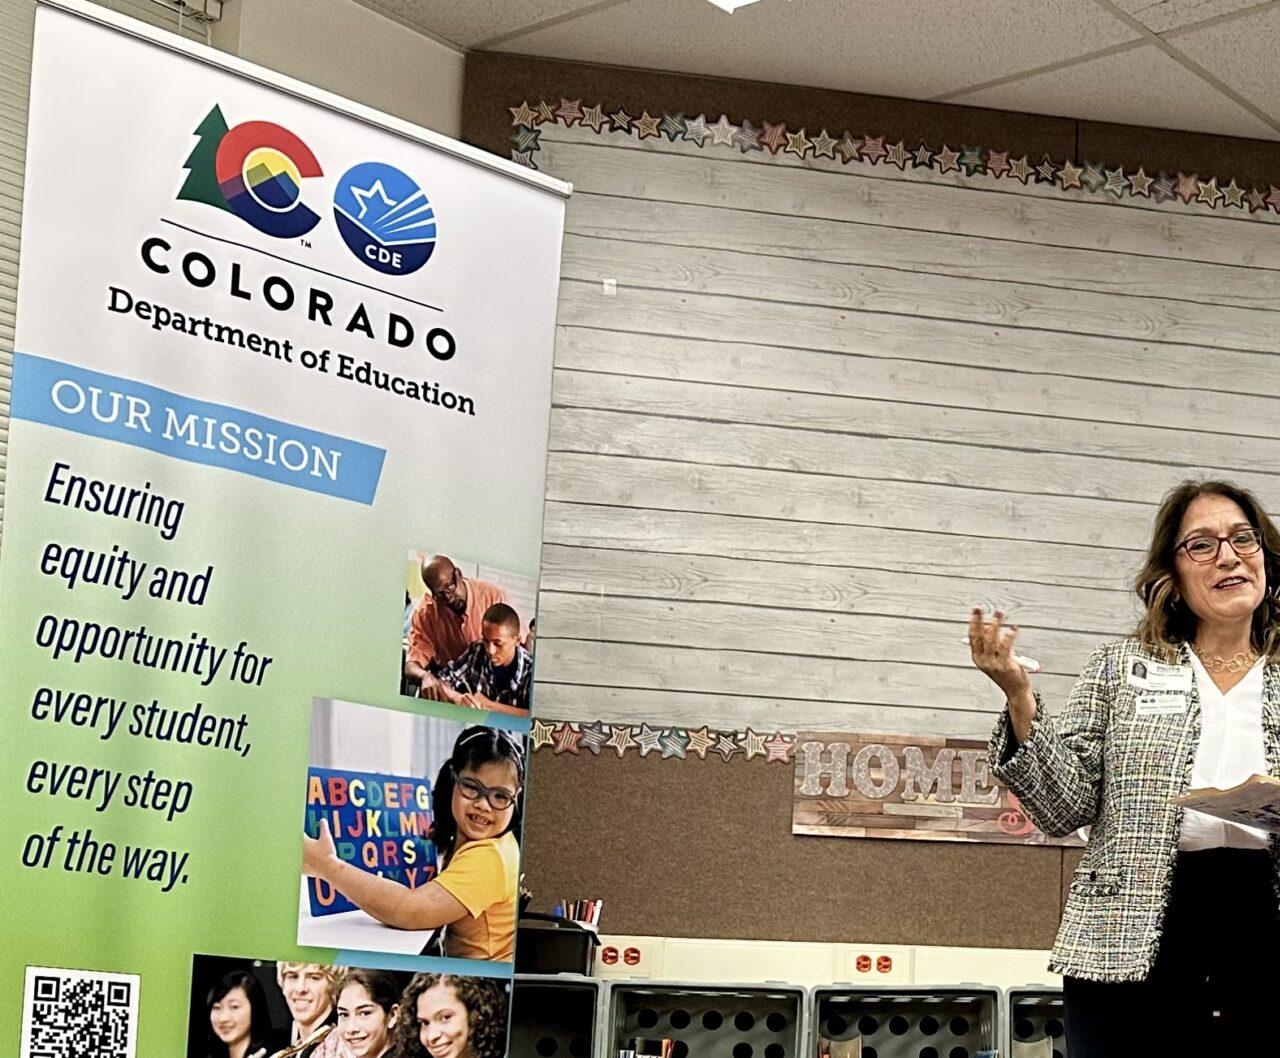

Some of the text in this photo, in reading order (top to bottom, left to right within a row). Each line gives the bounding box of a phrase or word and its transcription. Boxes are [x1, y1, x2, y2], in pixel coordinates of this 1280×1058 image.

[364, 244, 402, 269] CDE
[140, 237, 457, 361] COLORADO
[107, 286, 476, 415] Department of Education
[51, 379, 342, 481] OUR MISSION
[44, 462, 185, 541] Ensuring
[40, 542, 213, 606] equity and
[35, 613, 273, 687] opportunity for
[31, 687, 253, 757] every student,
[26, 759, 193, 821] every step
[799, 741, 1000, 805] HOME
[22, 826, 190, 892] of the way.
